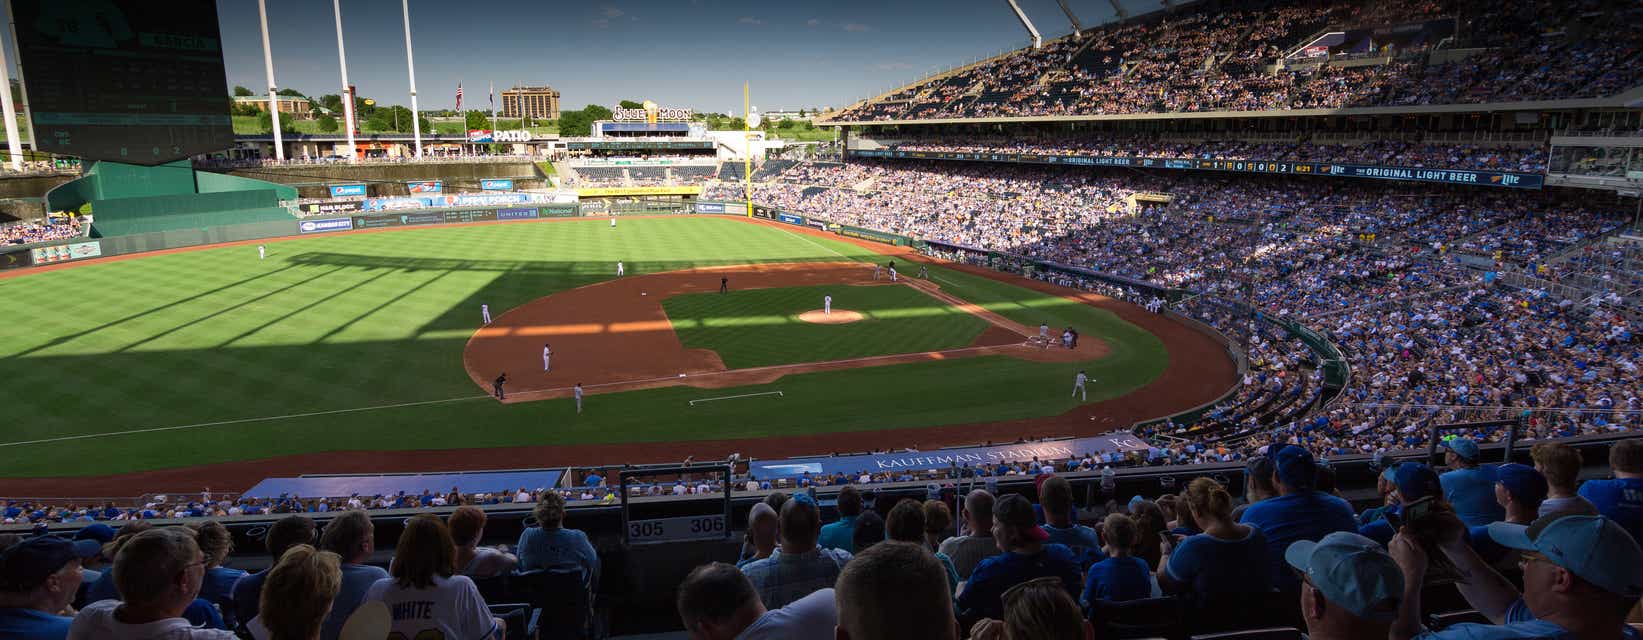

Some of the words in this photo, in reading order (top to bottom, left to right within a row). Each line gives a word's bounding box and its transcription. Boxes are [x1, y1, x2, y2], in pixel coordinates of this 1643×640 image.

[613, 105, 646, 121] BLUE
[659, 108, 692, 120] MOON
[494, 130, 531, 141] PATIO
[1330, 164, 1345, 174] Lite
[1366, 168, 1413, 178] ORIGINAL
[1416, 170, 1446, 180] LIGHT
[1450, 172, 1477, 182] BEER
[1502, 174, 1520, 186] Lite
[876, 453, 982, 469] KAUFFMAN
[986, 447, 1073, 460] STADIUM
[630, 521, 664, 537] 305
[690, 518, 724, 533] 306
[392, 601, 435, 620] WHITE
